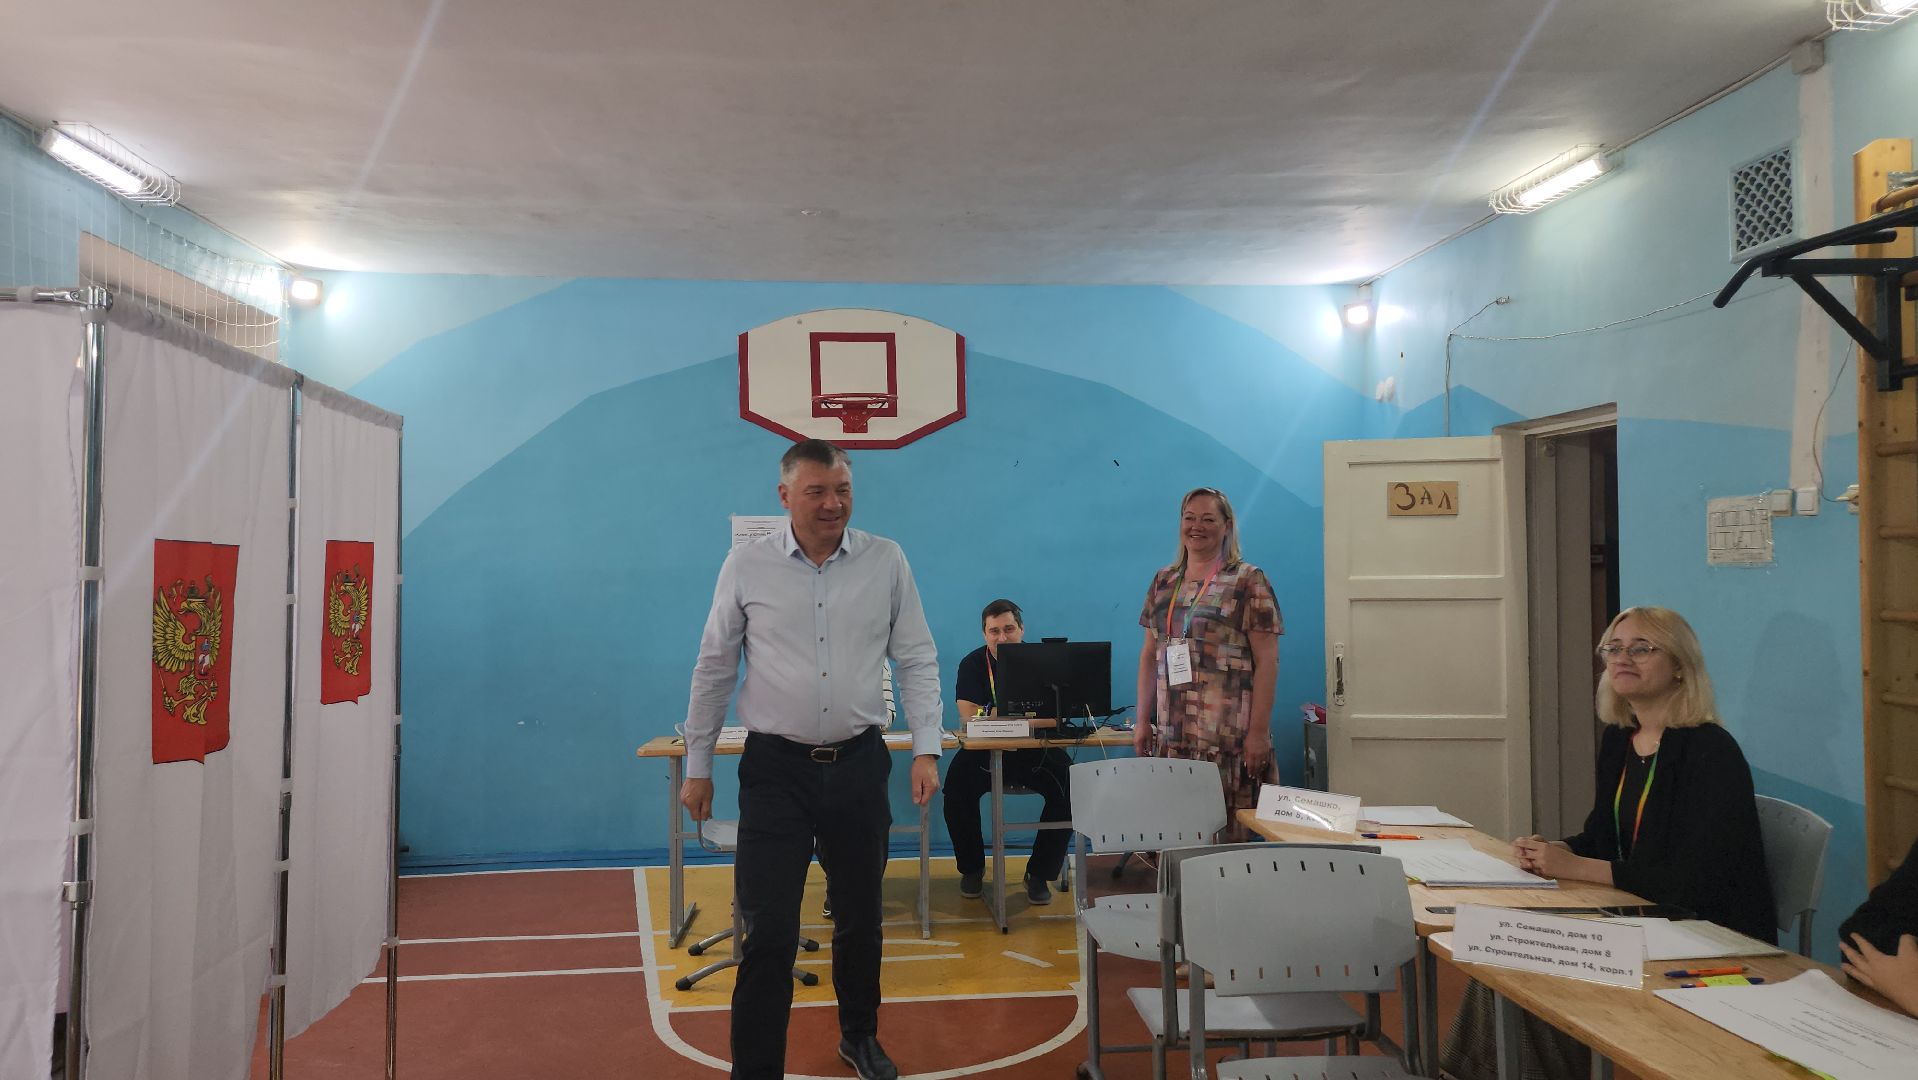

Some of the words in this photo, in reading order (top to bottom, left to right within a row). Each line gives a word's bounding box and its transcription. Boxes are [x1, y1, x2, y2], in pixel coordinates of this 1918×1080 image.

[1274, 809, 1293, 817] дом
[1277, 794, 1291, 802] ул.
[1294, 795, 1341, 811] Семашко,
[1499, 920, 1513, 928] ул.
[1516, 922, 1565, 938] Семашко,
[1567, 931, 1588, 940] дом
[1591, 933, 1603, 942] 10
[1489, 933, 1504, 941] ул.
[1507, 935, 1579, 954] Строительная,
[1581, 948, 1602, 957] дом
[1605, 949, 1612, 958] 8
[1468, 944, 1482, 952] ул.
[1484, 945, 1555, 964] Строительная,
[1558, 959, 1579, 967] дом
[1582, 961, 1597, 972] 14,
